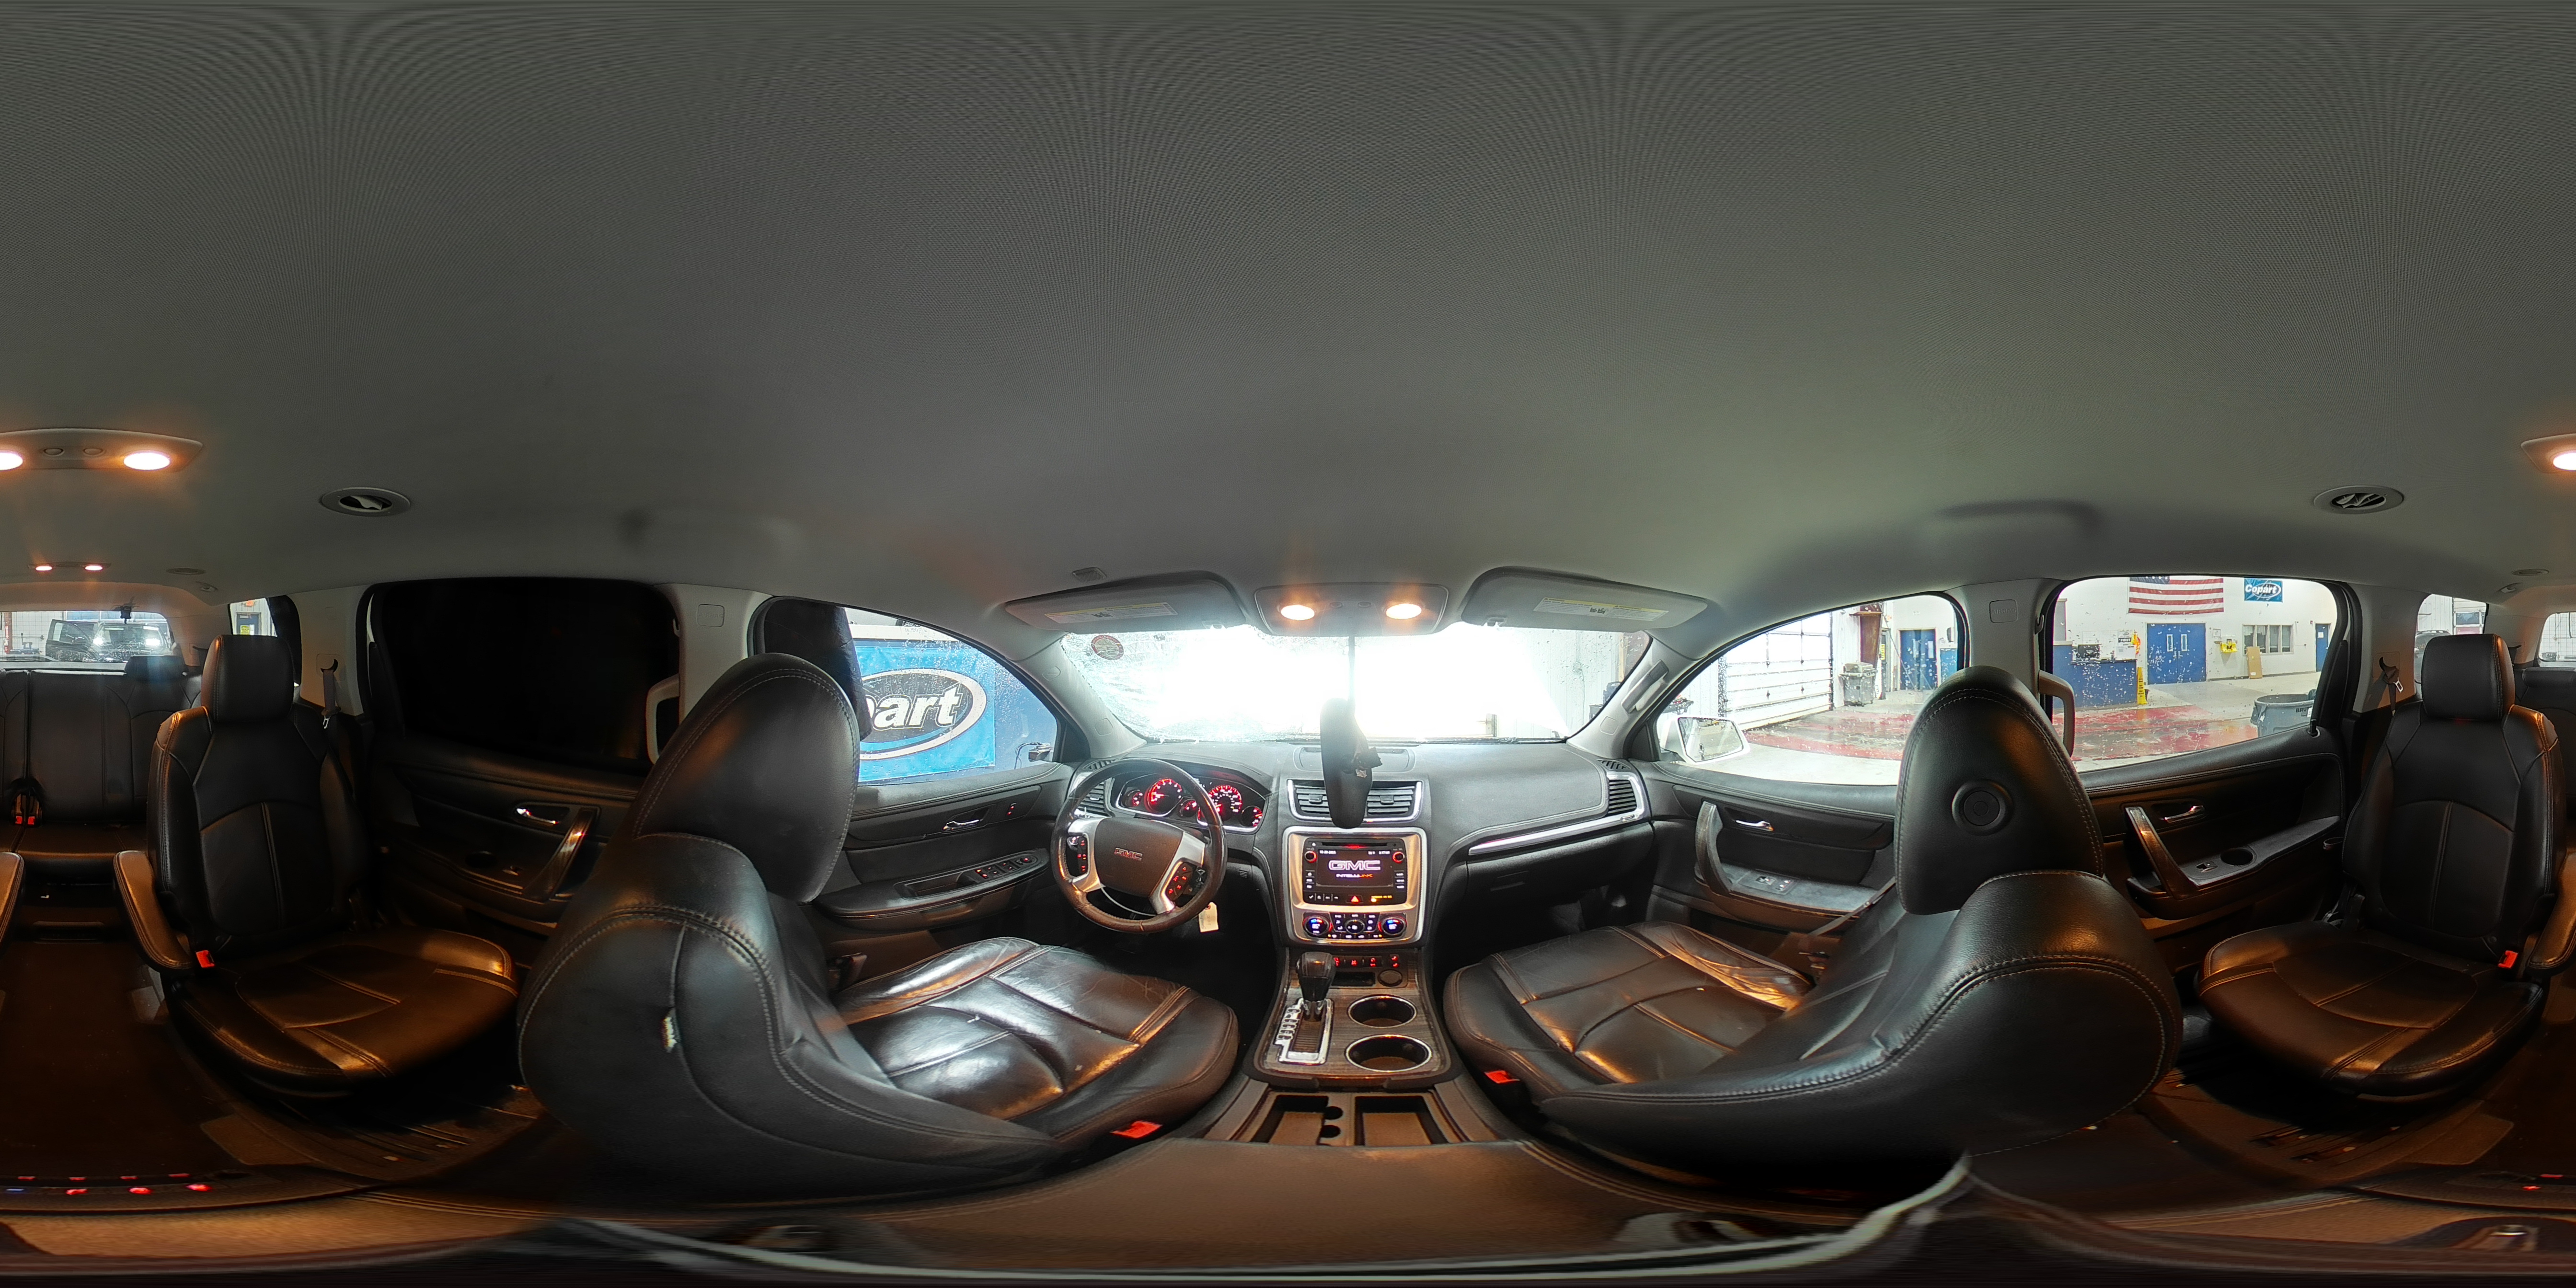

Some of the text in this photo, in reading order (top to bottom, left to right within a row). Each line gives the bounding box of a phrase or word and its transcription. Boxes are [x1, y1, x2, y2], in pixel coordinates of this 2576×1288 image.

[2245, 584, 2277, 594] Copart
[1114, 847, 1143, 861] GMC
[1328, 860, 1381, 870] GMC
